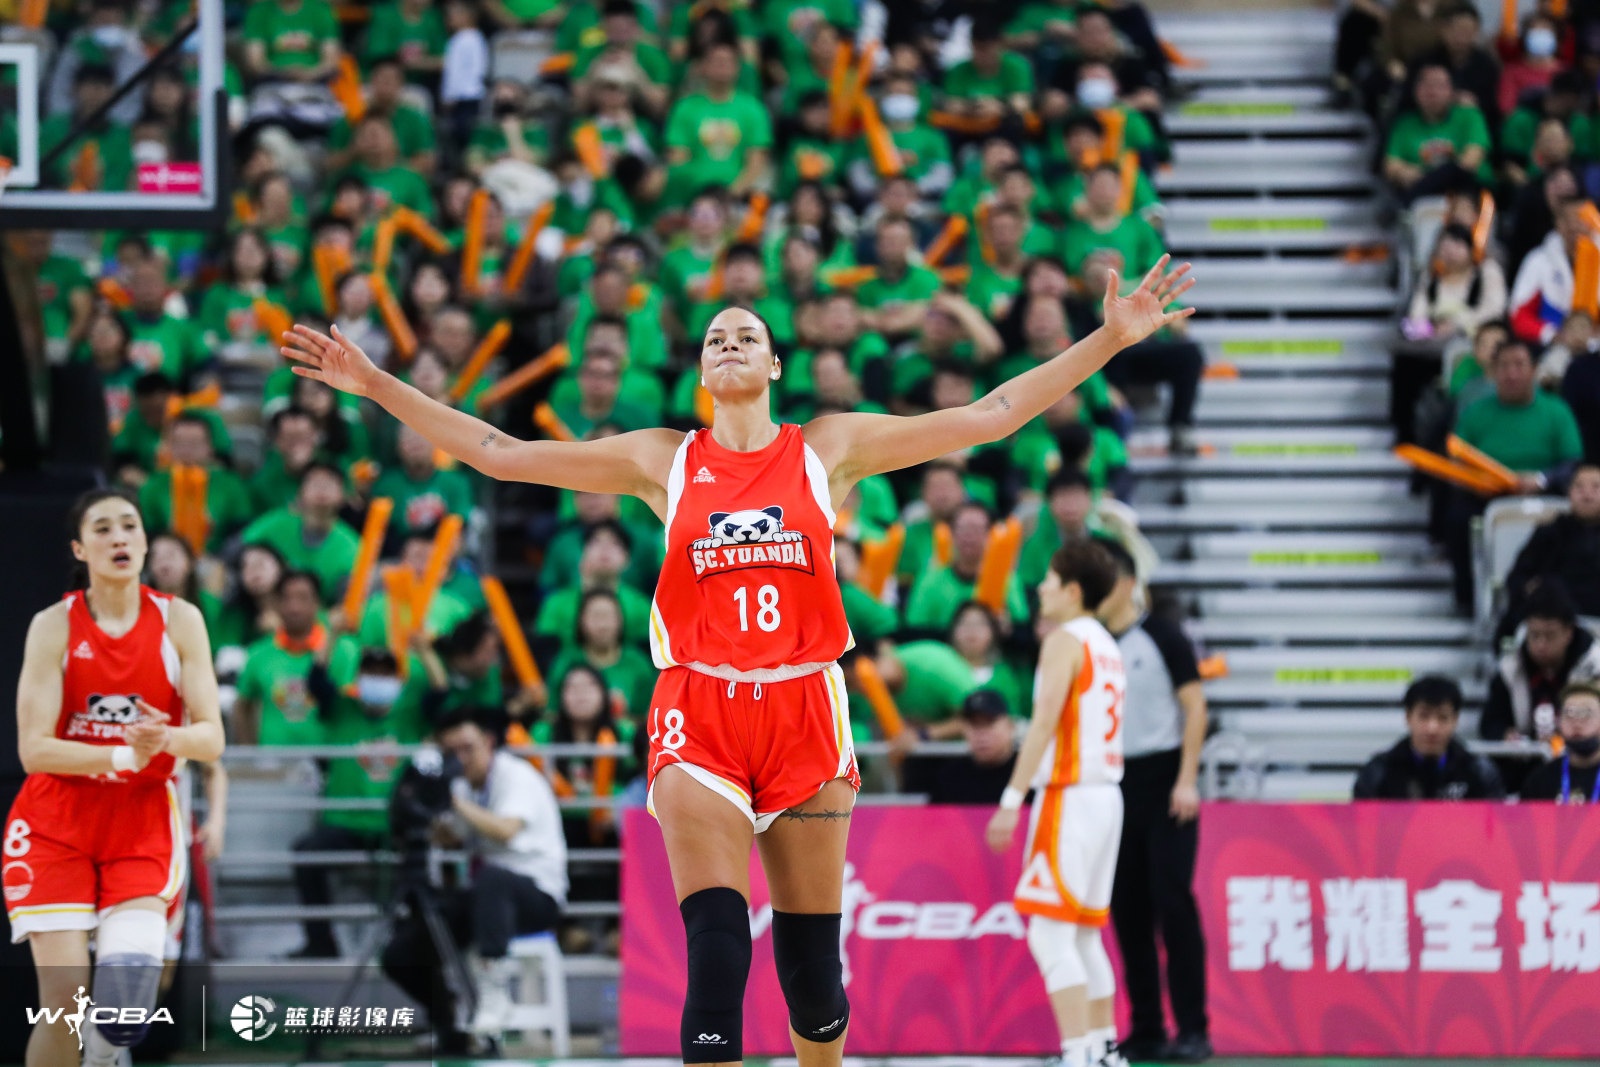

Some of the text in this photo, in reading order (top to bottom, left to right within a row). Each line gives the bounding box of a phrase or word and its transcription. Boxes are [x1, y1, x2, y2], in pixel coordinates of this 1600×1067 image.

[693, 475, 717, 484] PEAK
[692, 541, 808, 575] SC.YUANDA
[733, 584, 781, 632] 18
[1226, 876, 1600, 972] 我耀全场
